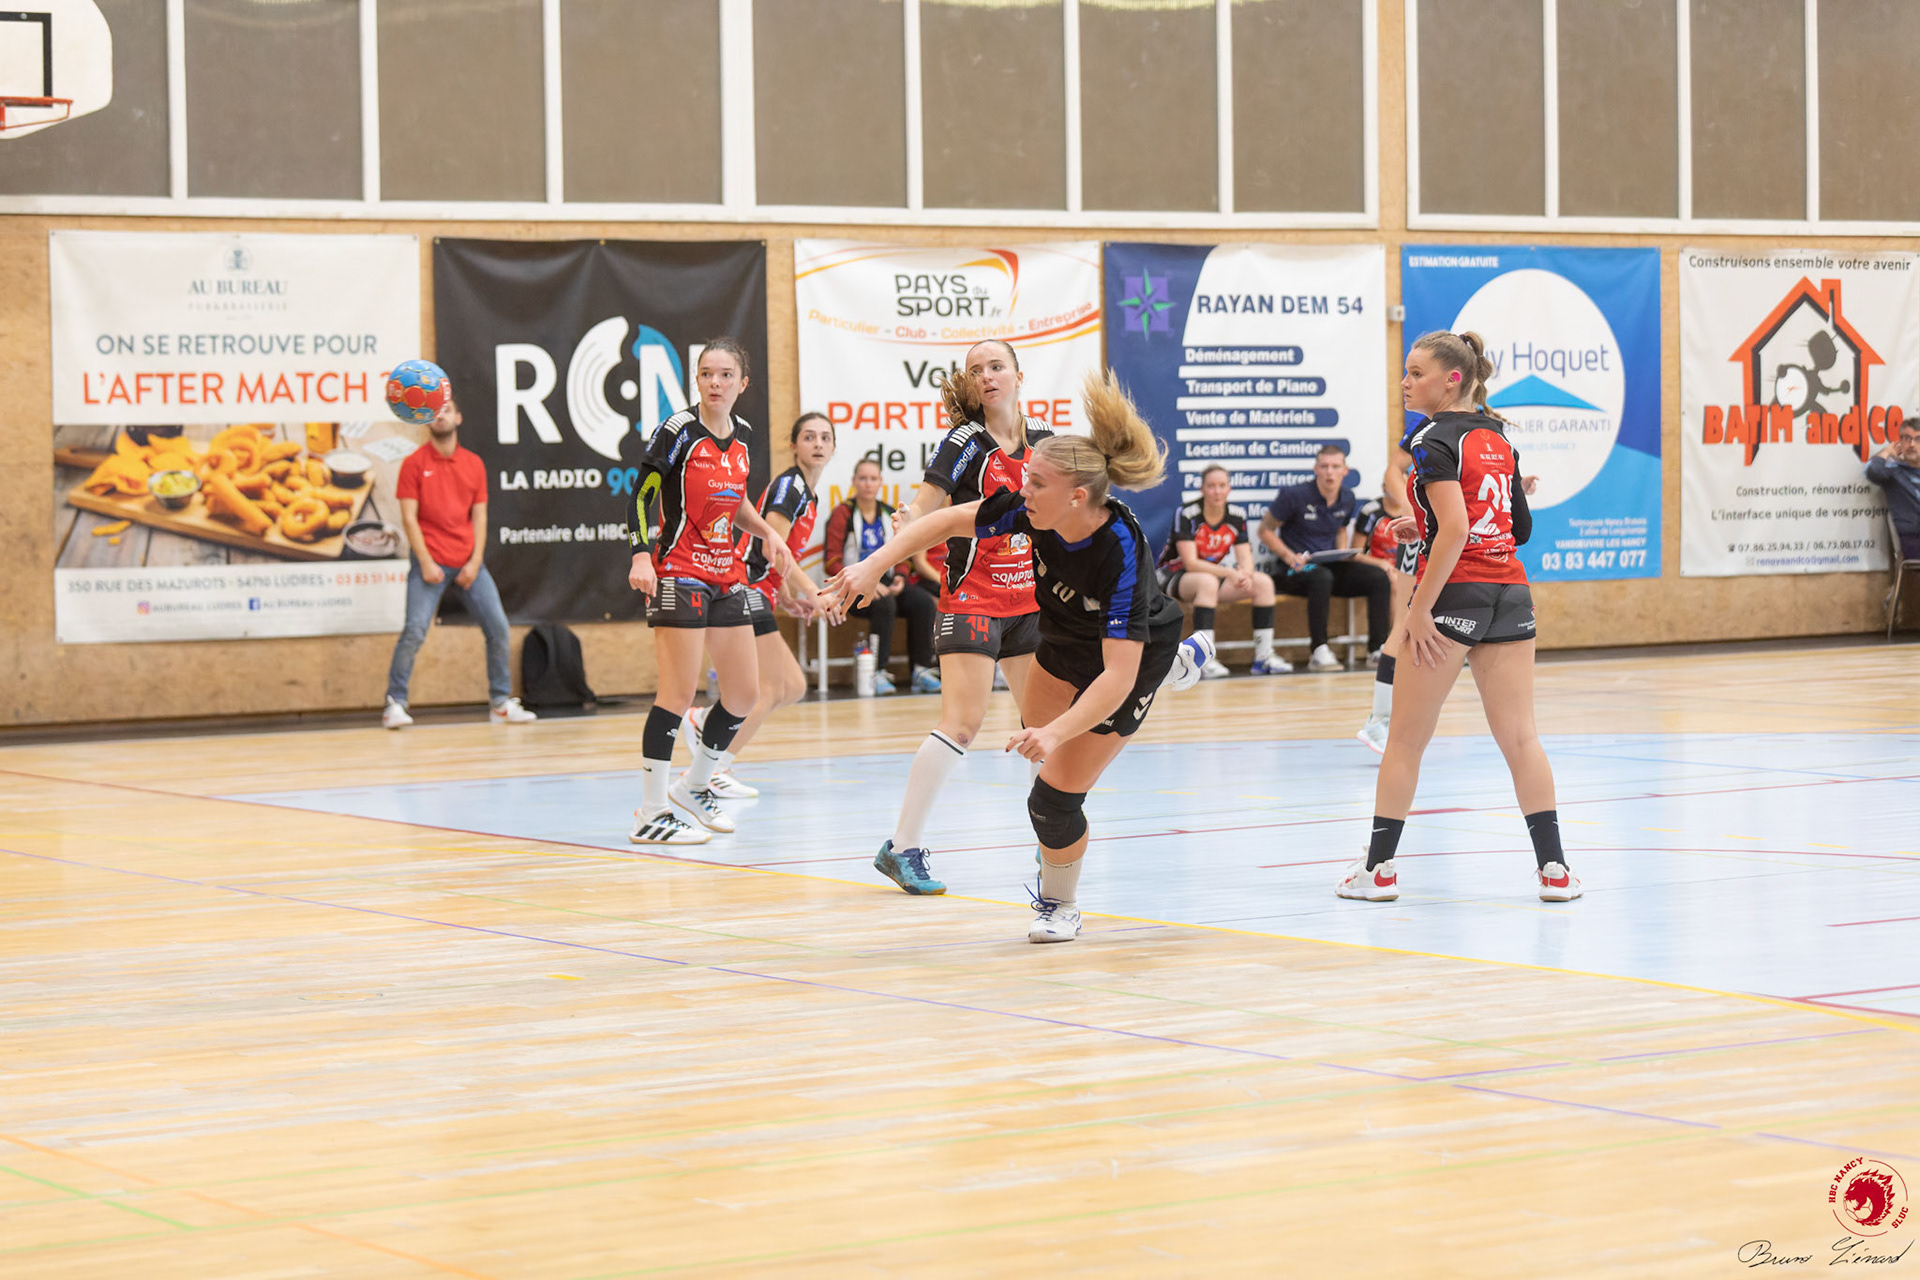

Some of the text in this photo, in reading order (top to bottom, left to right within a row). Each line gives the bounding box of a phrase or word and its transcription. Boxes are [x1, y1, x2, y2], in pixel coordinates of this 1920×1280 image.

[1408, 255, 1499, 268] ESTIMATION GRATUITE
[1689, 255, 1911, 271] Construisons ensemble votre avenir
[188, 280, 288, 295] AU BUREAU
[894, 275, 988, 296] PAYS du
[897, 296, 990, 318] SPORT
[1197, 295, 1364, 314] RAYAN DEM 54
[808, 309, 880, 336] Particulier
[895, 325, 927, 339] Club
[941, 324, 1015, 339] Collectivité
[1028, 302, 1092, 332] Entreprise
[96, 335, 378, 355] ON SE RETROUVE POUR
[1185, 347, 1295, 366] Déménagement
[1513, 342, 1610, 378] Hoquet
[83, 372, 224, 405] L'AFTER
[236, 371, 369, 405] MATCH
[1186, 379, 1317, 396] Transport de Piano
[1186, 410, 1315, 426] Vente de Matériels
[1548, 418, 1611, 433] GARANTI
[1702, 404, 1795, 446] BATIM
[1805, 405, 1861, 446] and
[1186, 442, 1245, 458] Location
[1248, 442, 1267, 456] de
[720, 453, 732, 476] 4
[500, 470, 529, 490] LA
[533, 468, 602, 489] RADIO
[708, 479, 744, 492] Guy Hoquet
[1736, 483, 1871, 497] Construction, rénovation
[1711, 509, 1771, 521] L'interface
[1776, 509, 1811, 520] unique
[1815, 507, 1828, 518] de
[1832, 509, 1849, 517] vos
[500, 524, 572, 544] Partenaire
[574, 523, 596, 541] du
[598, 523, 628, 540] HBC
[1621, 537, 1647, 547] NANCY
[1542, 549, 1647, 571] 03 83 447 077
[95, 580, 122, 592] RUE
[127, 578, 152, 592] DES
[274, 573, 325, 588] LUDRES
[691, 592, 702, 616] 4
[965, 615, 989, 642] 14
[1444, 616, 1476, 629] INTER
